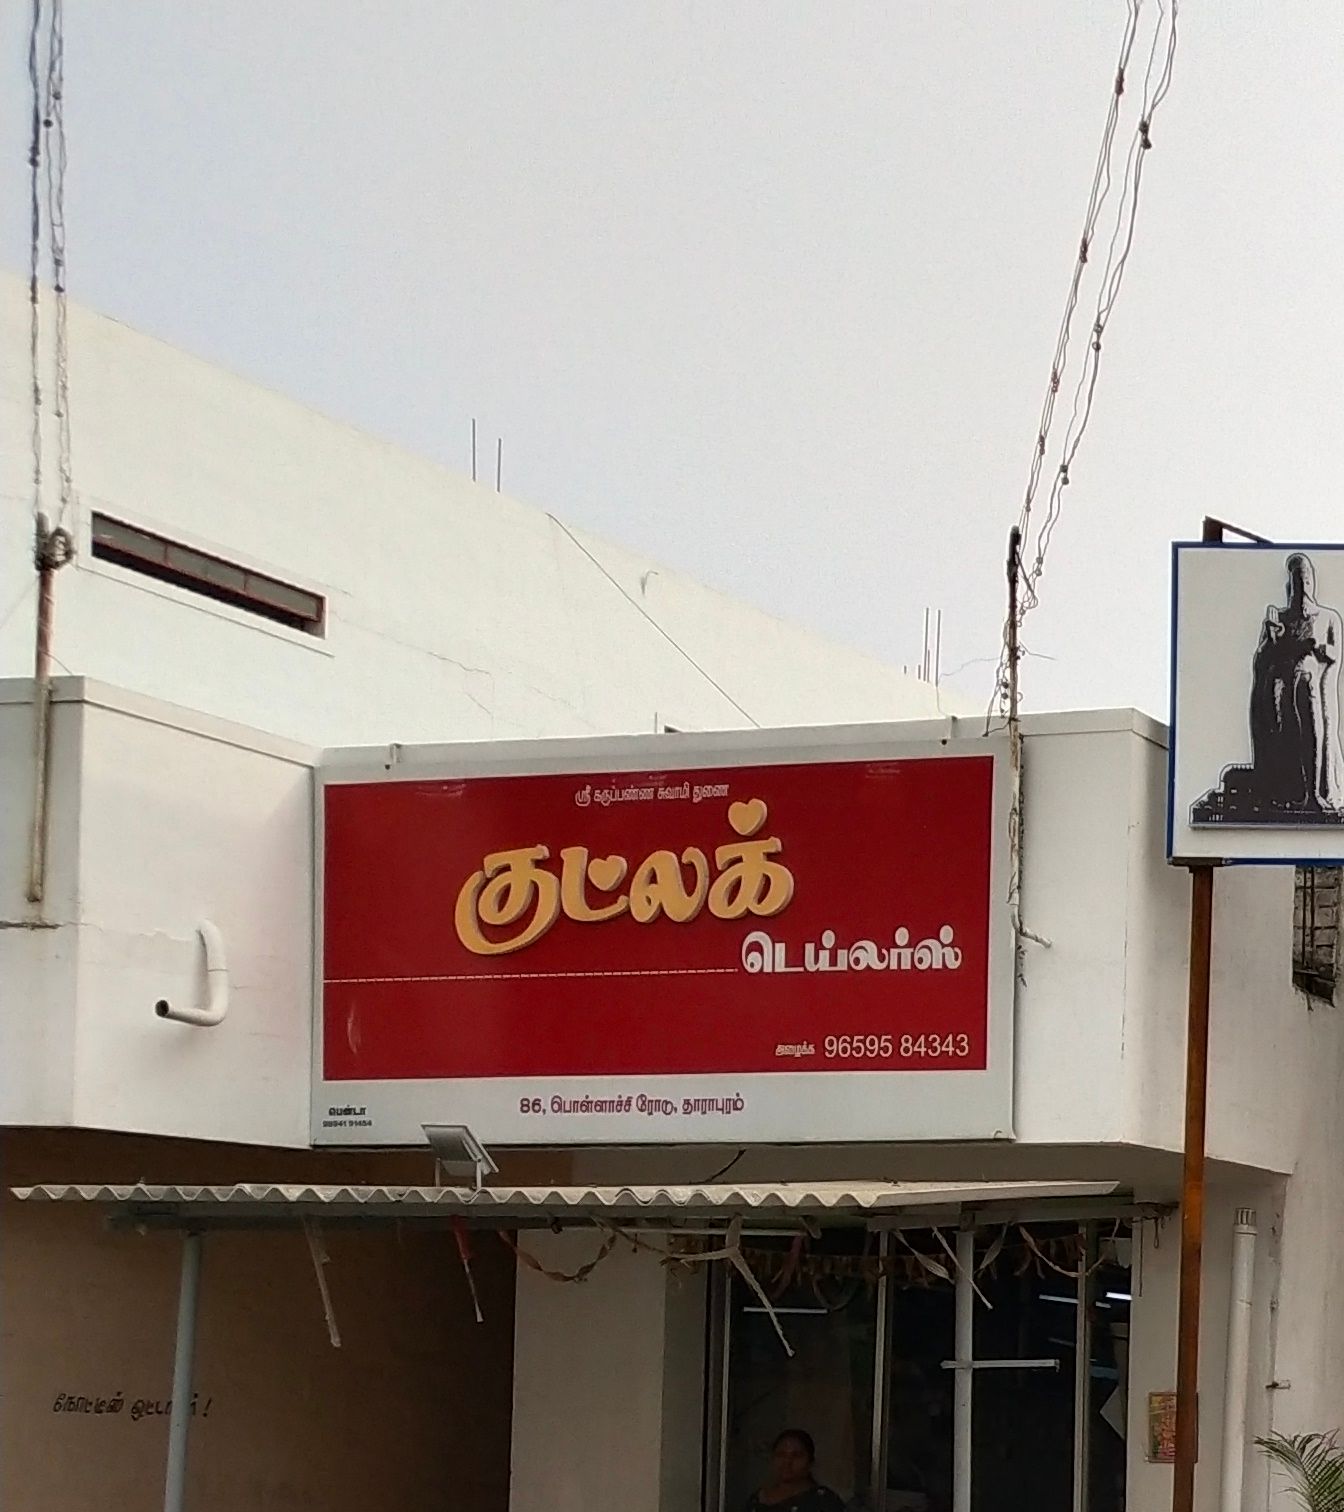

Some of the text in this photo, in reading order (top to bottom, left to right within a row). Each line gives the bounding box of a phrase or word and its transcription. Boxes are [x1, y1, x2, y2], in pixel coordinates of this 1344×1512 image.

[454, 798, 795, 956] குட்லக்
[741, 924, 963, 975] டெய்லர்ஸ்
[824, 1034, 893, 1058] 96595
[899, 1033, 969, 1058] 84343
[519, 1096, 546, 1116] 86,
[549, 1094, 634, 1115] பொள்ளாச்சி
[681, 1092, 745, 1115] தாராபுரம்
